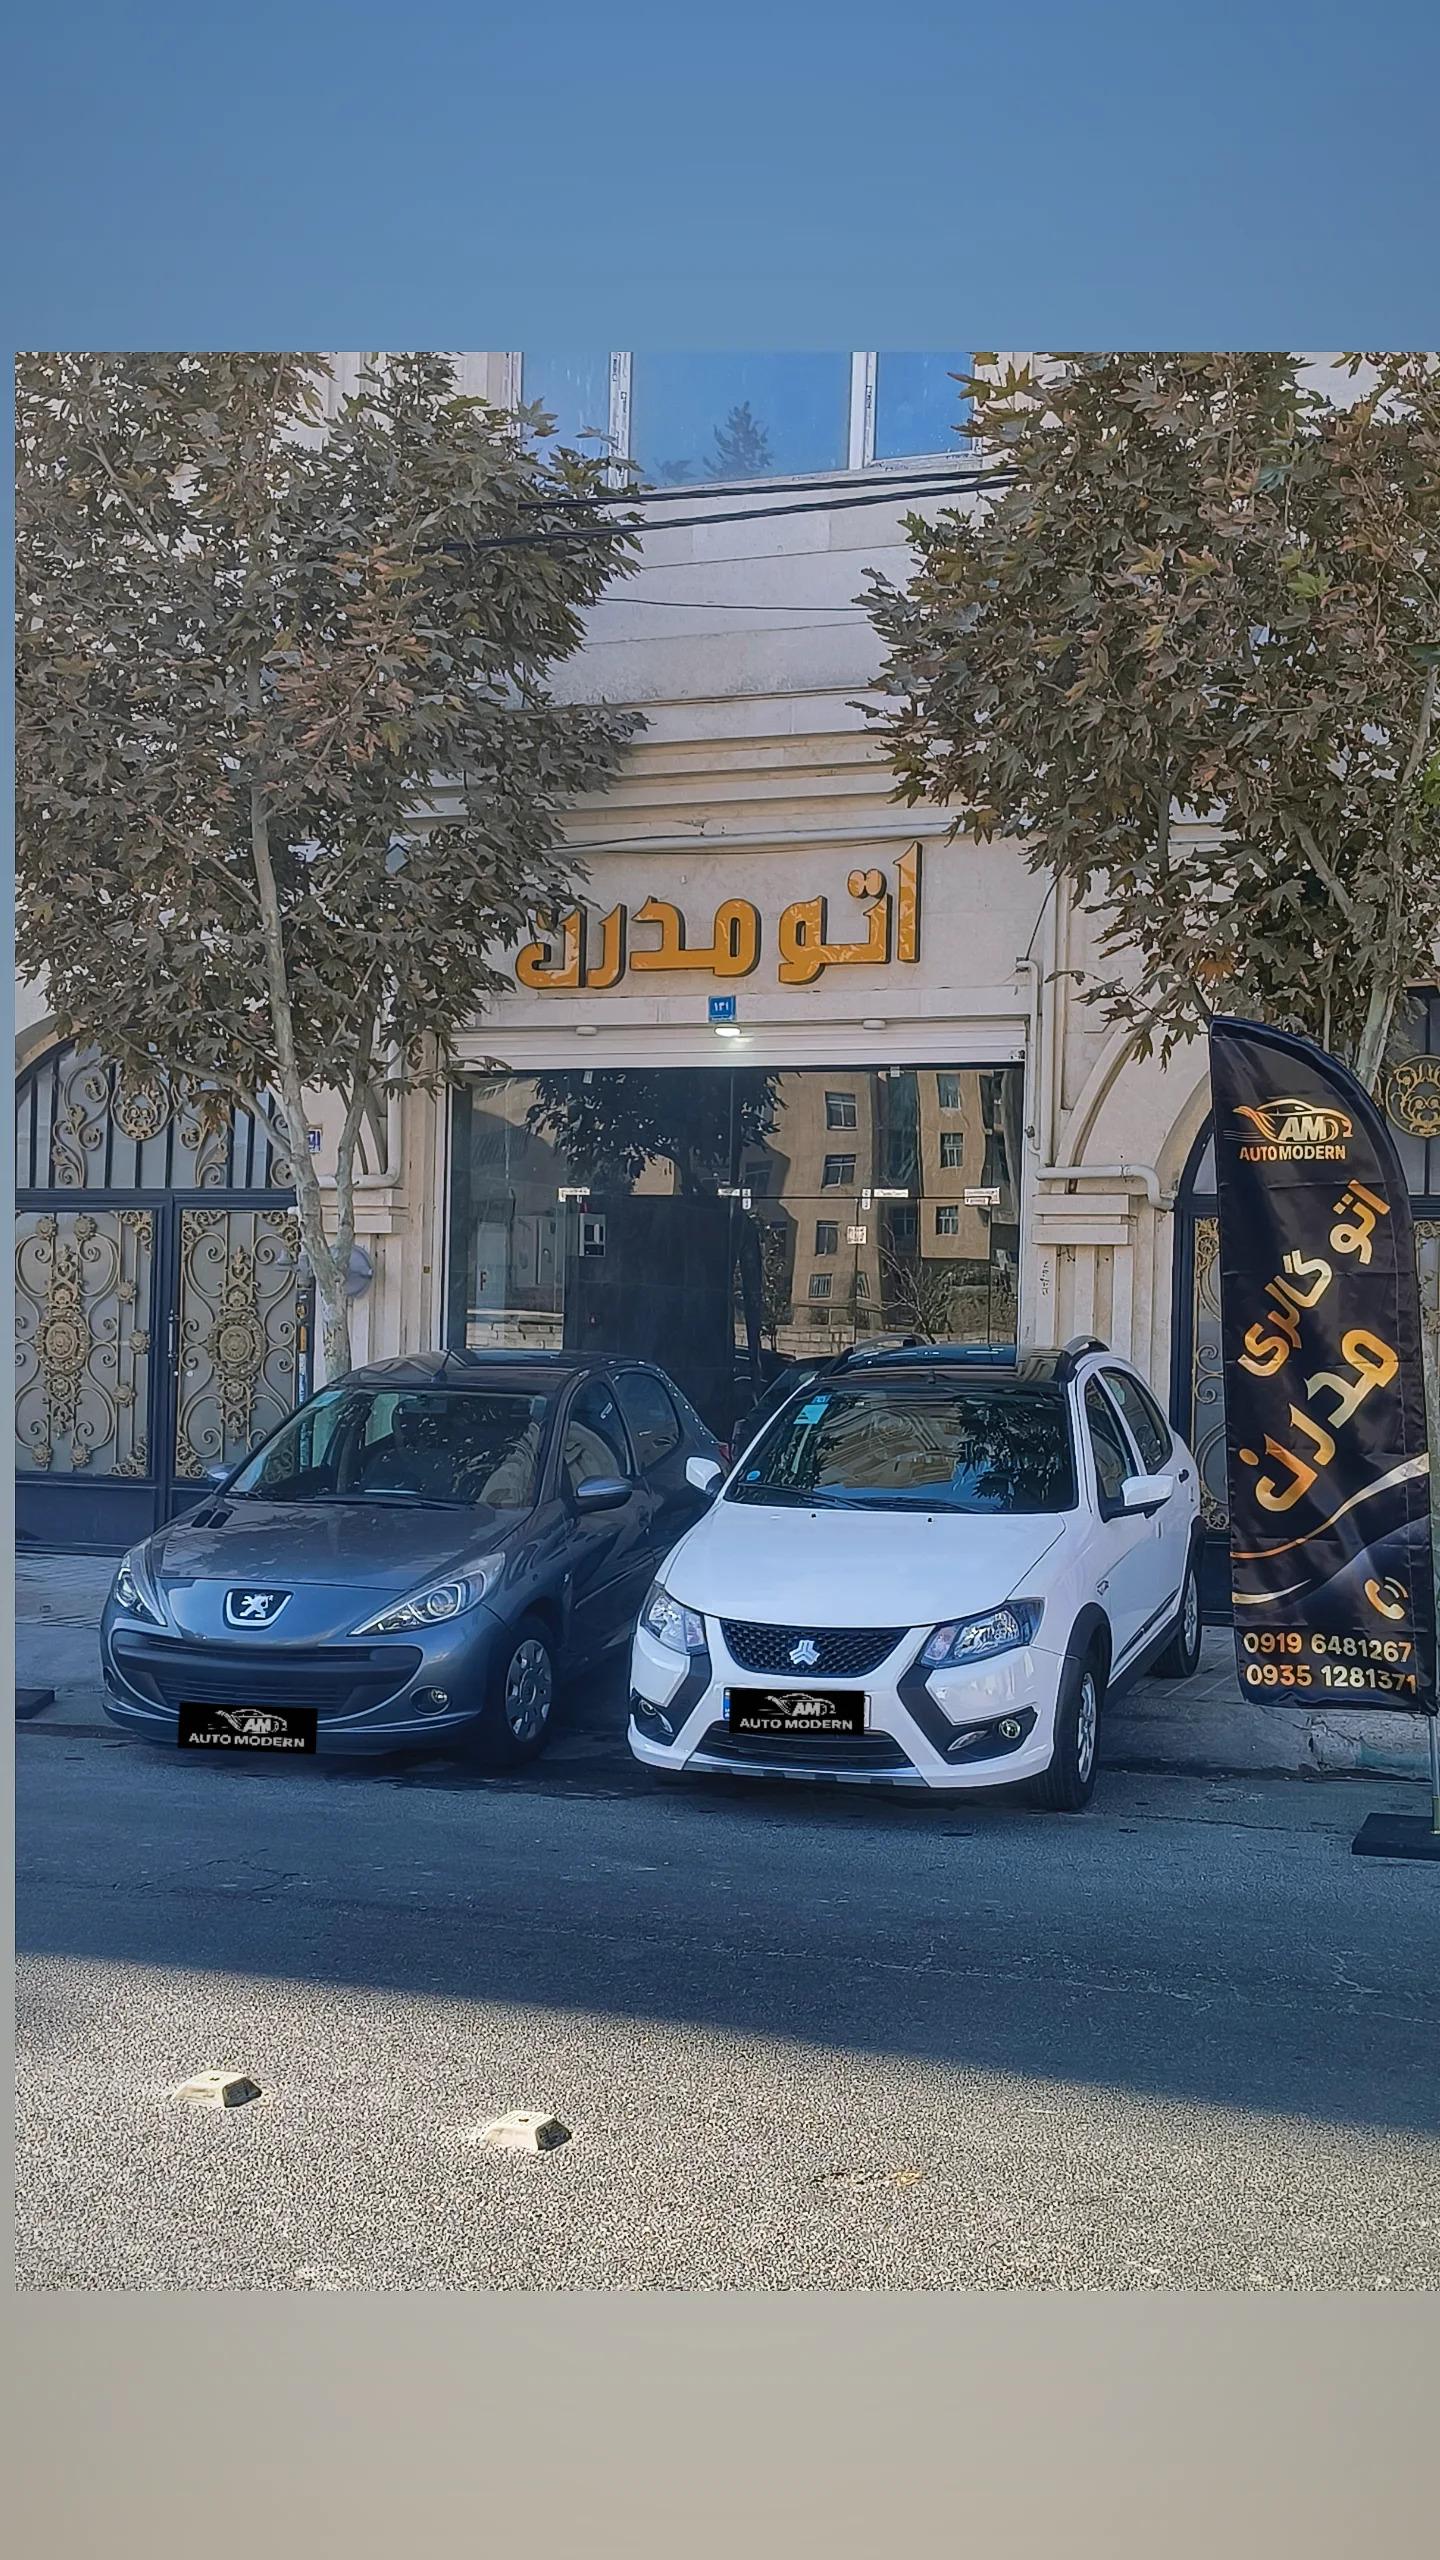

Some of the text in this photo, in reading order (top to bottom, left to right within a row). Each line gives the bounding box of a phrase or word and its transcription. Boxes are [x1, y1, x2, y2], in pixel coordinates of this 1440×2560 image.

[515, 841, 923, 990] اتو مدرن
[1278, 1115, 1328, 1142] AM
[1239, 1144, 1346, 1162] AUTO MODERN
[1237, 1179, 1391, 1377] اتو گالری
[1239, 1328, 1400, 1512] مدرن
[1243, 1632, 1413, 1663] 0919 6481267
[1246, 1664, 1417, 1695] 0935 1281371
